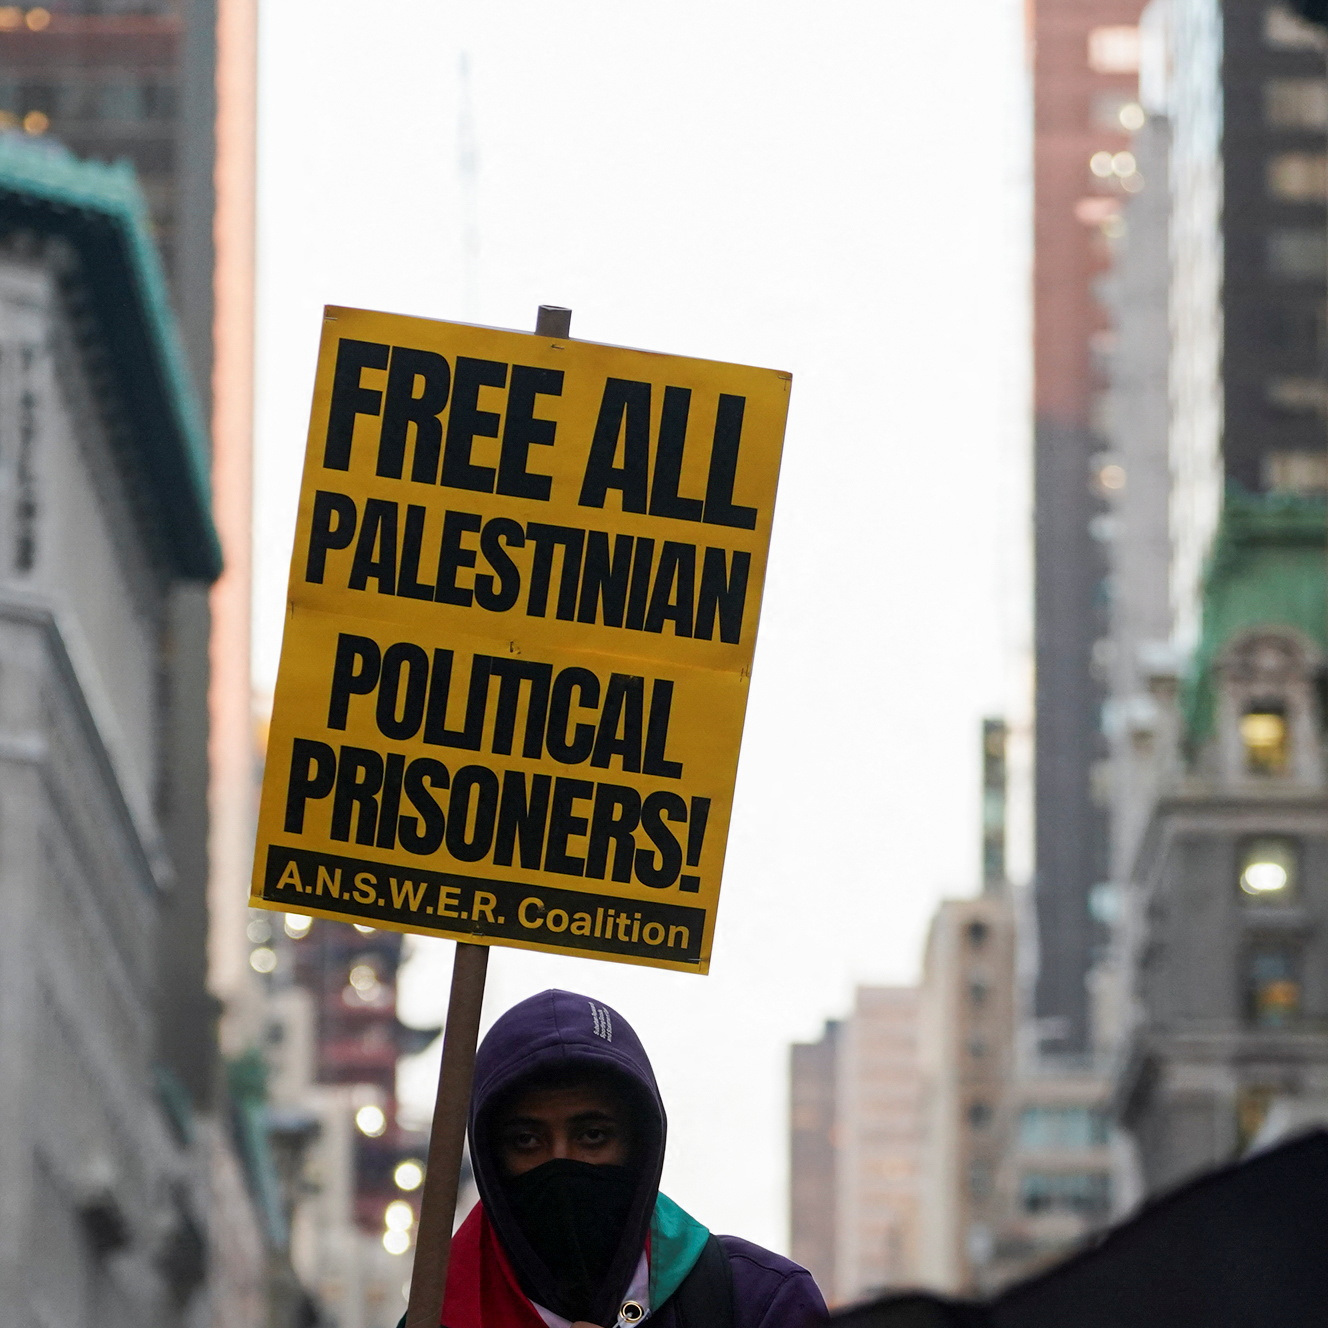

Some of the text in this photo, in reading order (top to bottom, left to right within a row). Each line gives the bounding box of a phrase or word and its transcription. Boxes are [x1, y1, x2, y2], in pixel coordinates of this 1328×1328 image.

[323, 338, 759, 531] FREE ALL
[305, 490, 751, 645] PALESTINIAN
[327, 632, 683, 779] POLITICAL
[284, 738, 712, 893] PRISONERS!
[276, 860, 691, 949] A.N.S.W.E.R. Coalition
